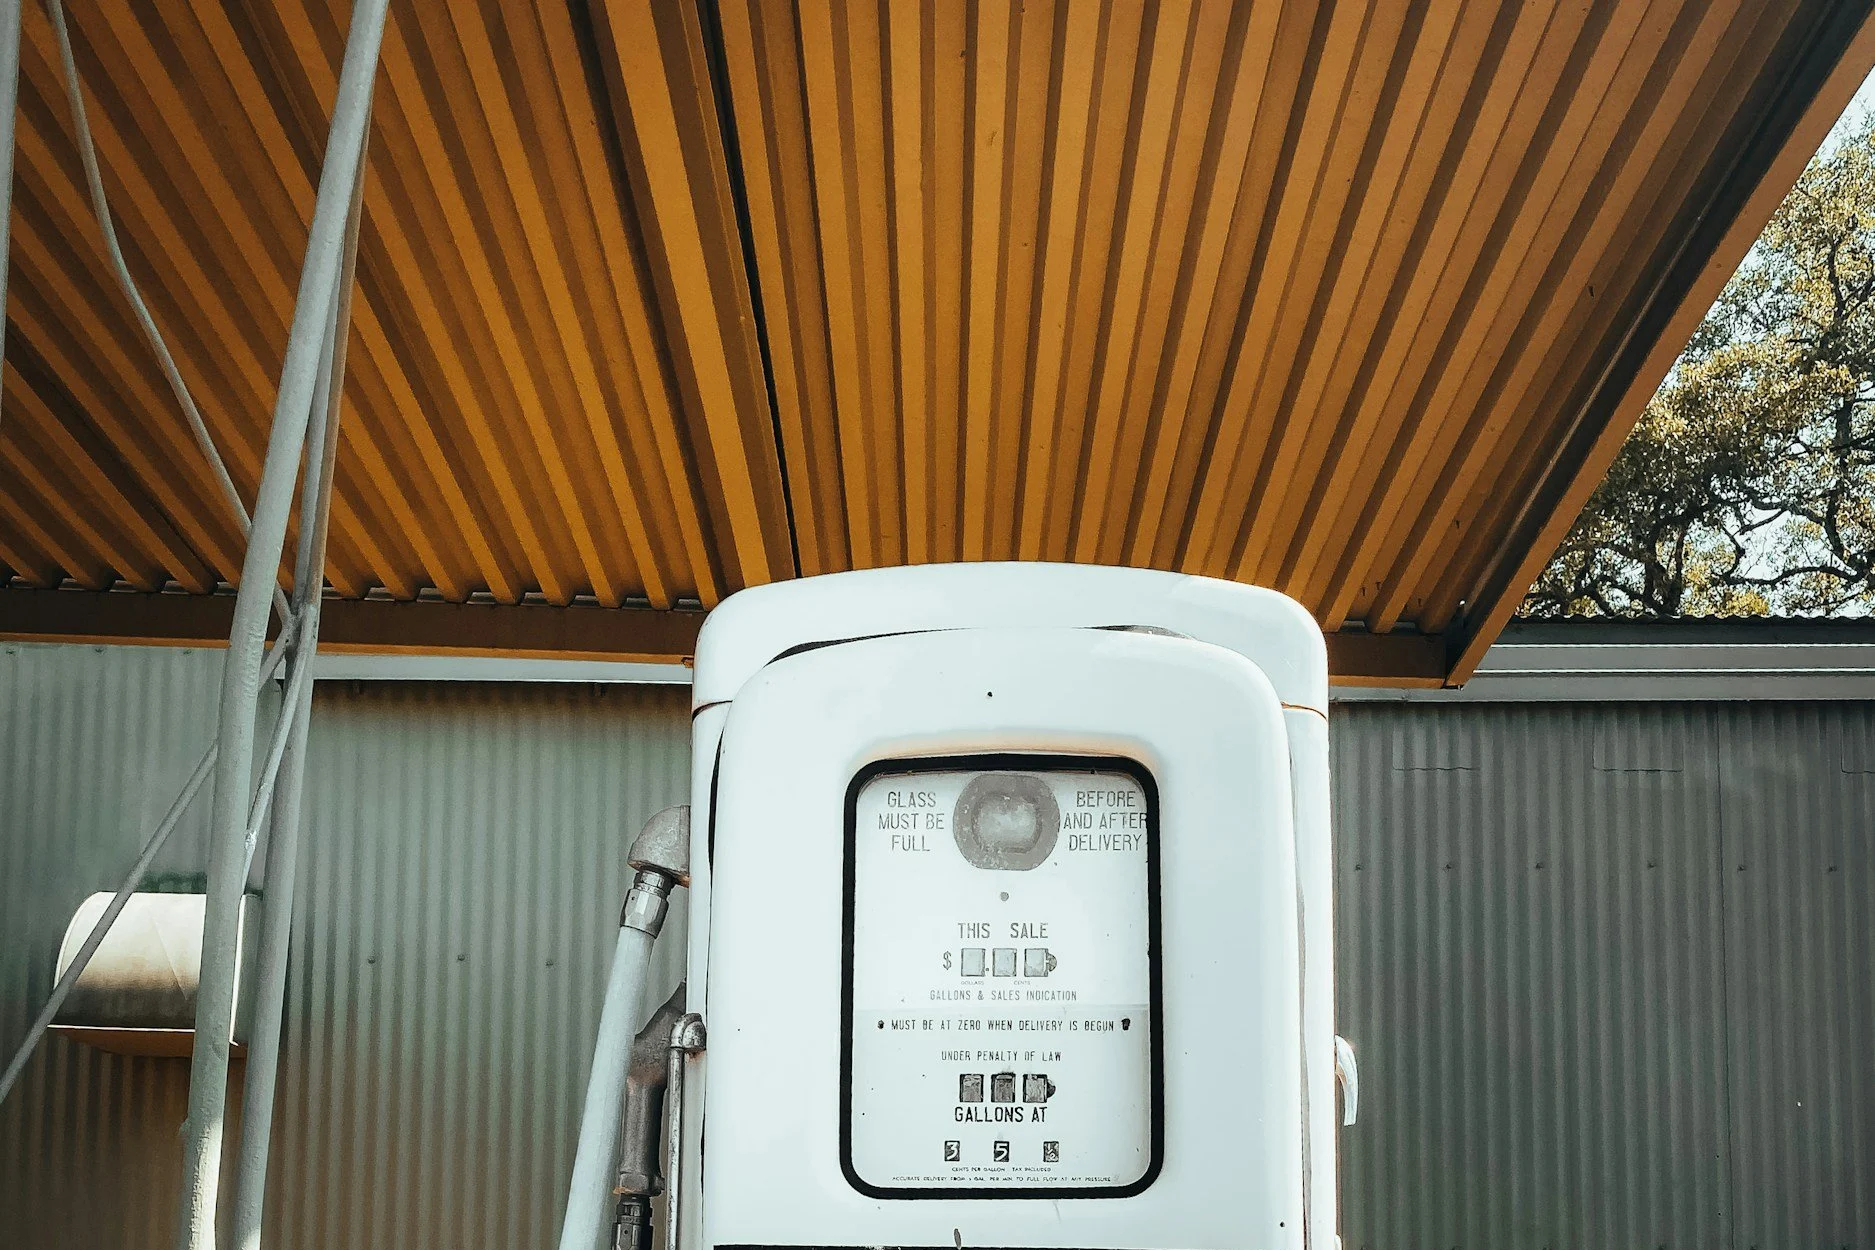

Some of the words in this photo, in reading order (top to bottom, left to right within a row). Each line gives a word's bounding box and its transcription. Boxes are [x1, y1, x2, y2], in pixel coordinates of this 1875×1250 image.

[888, 791, 937, 808] GLASS
[1077, 790, 1136, 808] BEFORE
[878, 813, 919, 830] MUST
[926, 813, 945, 830] BE
[1063, 812, 1093, 829] AND
[1099, 812, 1148, 829] AFTER
[891, 834, 931, 852] FULL
[1069, 834, 1142, 851] DELIVERY
[957, 922, 991, 939] THIS
[1010, 922, 1049, 939] SALE
[942, 950, 952, 971] $
[930, 989, 971, 1001] GALLONS
[977, 989, 985, 1001] &
[991, 989, 1020, 1001] SALES
[1026, 990, 1077, 1001] INDICATION
[891, 1019, 916, 1030] MUST
[922, 1019, 934, 1030] BE
[940, 1019, 951, 1030] AT
[957, 1019, 981, 1030] ZERO
[987, 1020, 1013, 1031] WHEN
[1019, 1020, 1063, 1031] DELIVERY
[1069, 1020, 1078, 1031] IS
[1084, 1020, 1114, 1031] BEGUN
[941, 1050, 971, 1061] UNDER
[977, 1050, 1018, 1061] PENALTY
[1024, 1051, 1035, 1061] OF
[1042, 1051, 1062, 1062] LAW
[954, 1106, 1024, 1123] GALLONS
[1031, 1106, 1048, 1123] AT
[945, 1141, 959, 1160] 3
[994, 1142, 1008, 1161] 5
